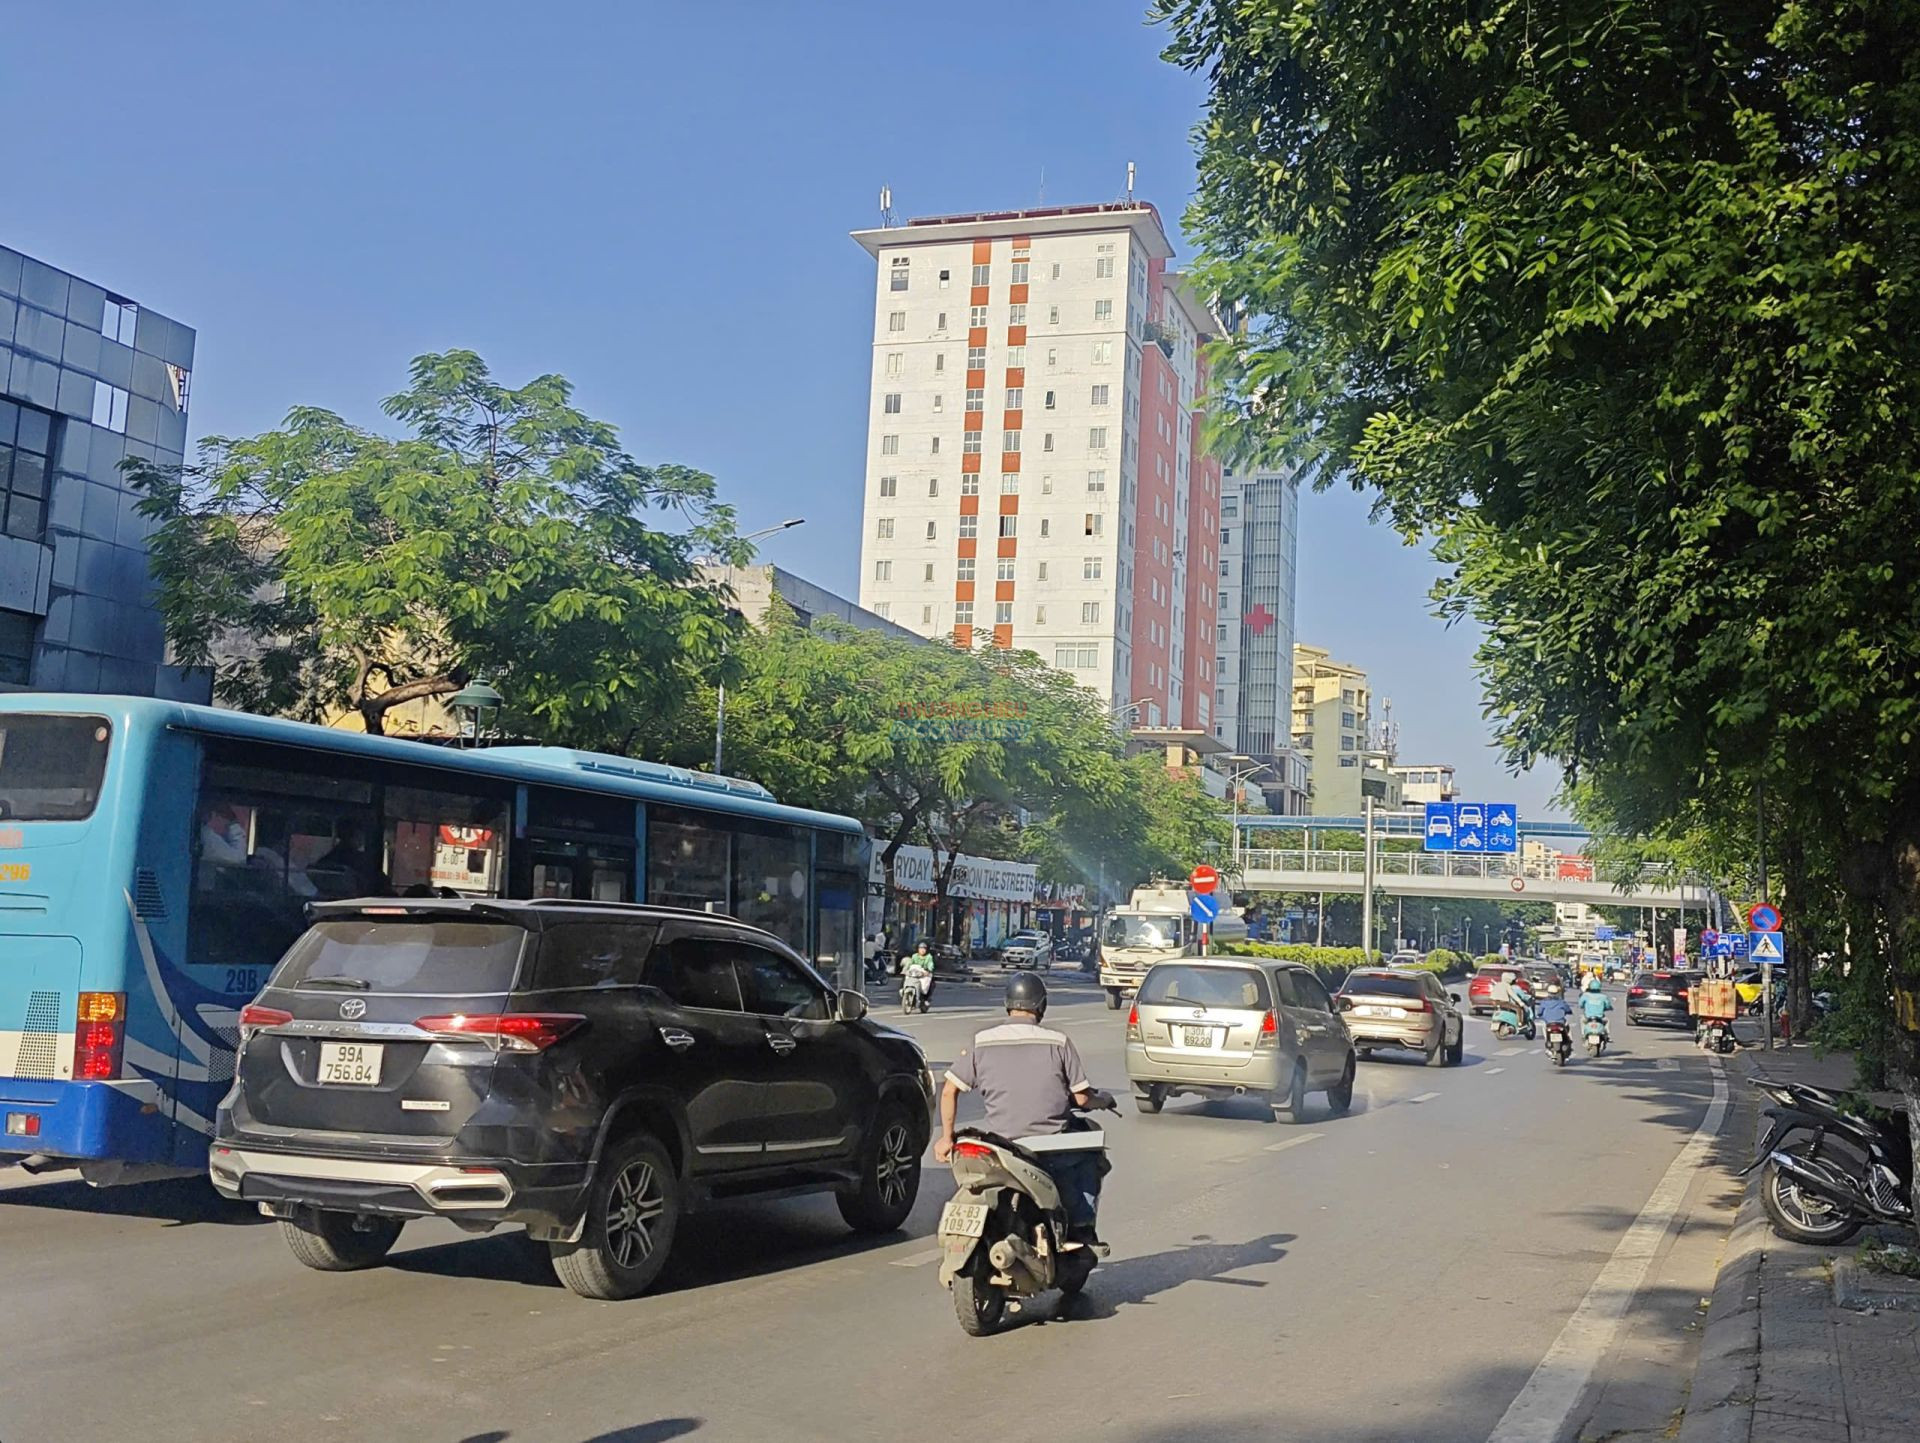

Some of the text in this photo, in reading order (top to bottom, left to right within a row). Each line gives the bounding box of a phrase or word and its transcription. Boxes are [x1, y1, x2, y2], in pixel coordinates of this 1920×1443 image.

[875, 851, 930, 881] ERYDAY
[968, 866, 982, 888] ON
[984, 868, 1000, 889] THE
[1000, 871, 1034, 892] STREETS
[225, 968, 257, 992] 29B
[338, 1046, 363, 1063] 99A
[326, 1063, 372, 1081] 756.84
[949, 1204, 981, 1219] 24-B3
[944, 1217, 981, 1233] 109.77
